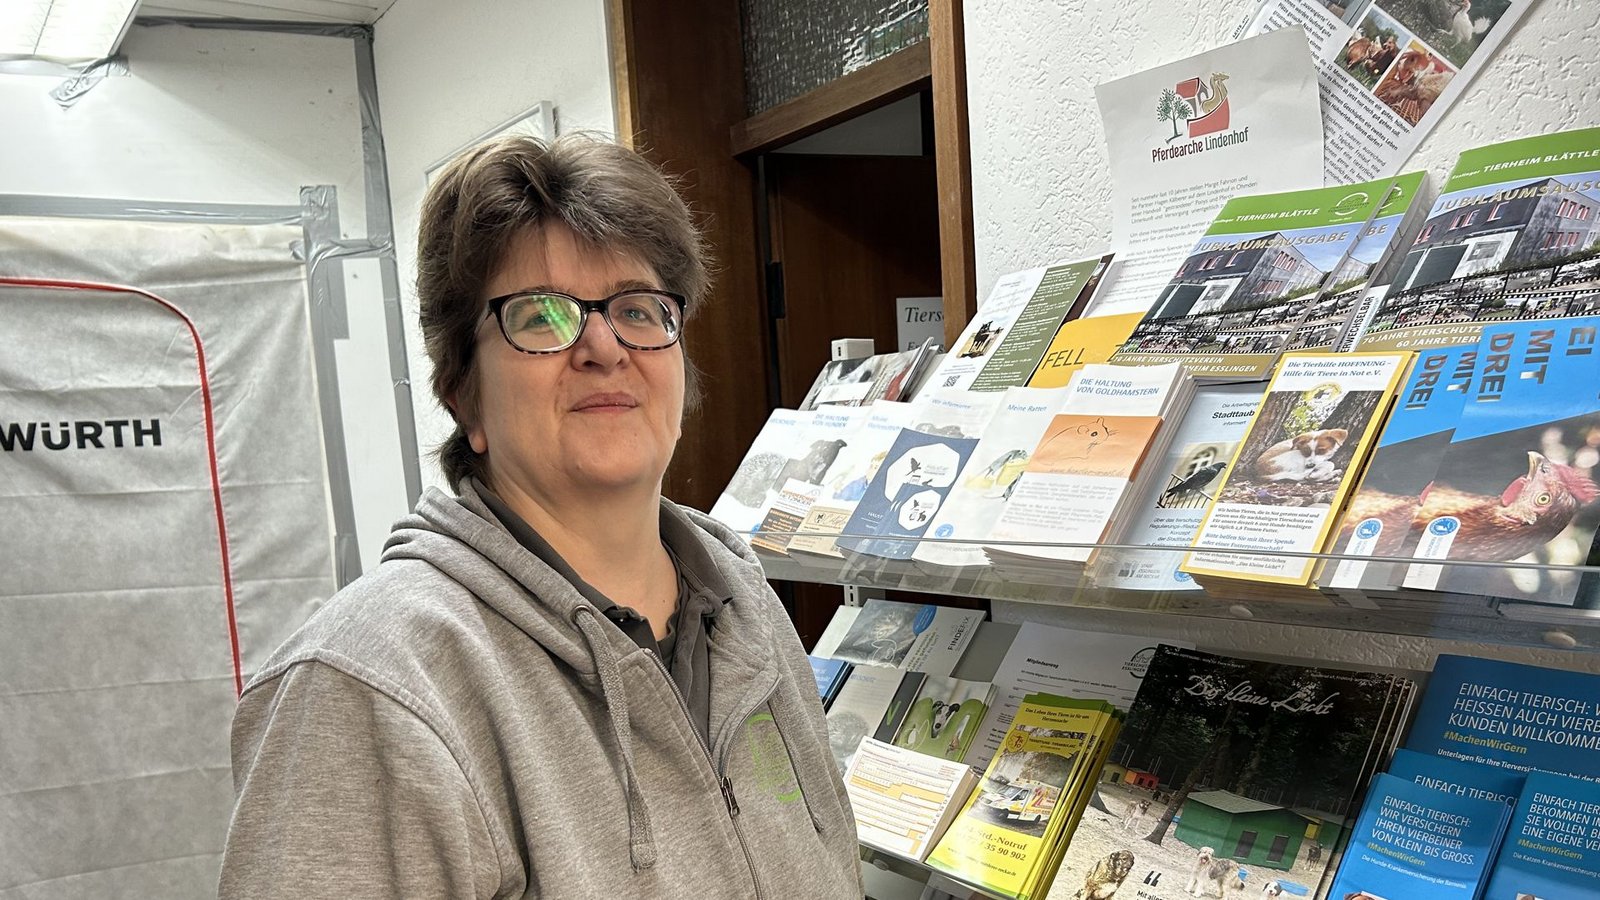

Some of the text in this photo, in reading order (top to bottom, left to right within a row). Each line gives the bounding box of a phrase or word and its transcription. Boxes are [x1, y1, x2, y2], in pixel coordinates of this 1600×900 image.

[1333, 68, 1347, 83] Monate
[1348, 80, 1359, 92] alten
[1359, 90, 1374, 105] Hennen
[1152, 126, 1249, 163] Pferdearche Lindenhof
[1385, 138, 1398, 151] Leben
[1483, 149, 1600, 173] TIERHEIM BLÄTTLE
[1235, 211, 1279, 222] TIERHEIM
[1278, 208, 1321, 219] BLÄTTLE
[1197, 231, 1349, 252] JUBILÄUMSAUSGABE
[1361, 335, 1375, 345] 70
[1375, 330, 1411, 344] JAHRE
[1396, 338, 1411, 348] 60
[1411, 336, 1449, 347] JAHRE
[1041, 347, 1085, 370] FELL
[1148, 356, 1225, 364] TIERSCHUTZVEREIN
[1476, 332, 1515, 403] DREI
[1519, 329, 1556, 385] MIT
[1207, 365, 1258, 373] ESSLINGEN
[1348, 369, 1365, 377] Not
[1446, 351, 1478, 394] MIT
[1079, 378, 1132, 388] DIE HALTUNG
[1095, 387, 1160, 396] GOLDHAMSTERN
[1404, 354, 1448, 411] DREI
[1007, 404, 1027, 412] Meine
[1212, 410, 1256, 420] Stadttaub
[1271, 692, 1340, 715] Licht
[1459, 682, 1519, 704] EINFACH
[1522, 692, 1591, 715] TIERISCH:
[1448, 712, 1509, 735] KUNDEN
[1453, 697, 1514, 720] HEISSEN
[1515, 708, 1558, 728] AUCH
[1443, 730, 1528, 755] #MachenWirGern
[1437, 748, 1475, 762] Unterlagen
[1475, 755, 1486, 765] für
[1486, 757, 1501, 767] Ihre
[1414, 774, 1466, 797] EINFACH
[1384, 795, 1472, 828] EINFACH TIERISCH:
[1533, 792, 1577, 810] EINFACH
[1379, 806, 1462, 837] WIR VERSICHERN
[1526, 814, 1542, 828] SIE
[1542, 817, 1588, 837] WOLLEN.
[1529, 804, 1590, 825] BEKOMMEN
[1375, 818, 1463, 850] IHREN VIERBEINER
[1521, 825, 1544, 839] EINE
[1546, 831, 1584, 848] EIGENE
[984, 842, 1027, 861] 35 90 902
[1361, 854, 1372, 863] Die
[1366, 841, 1426, 868] #MachenWirGern
[1371, 828, 1475, 866] VON KLEIN BIS GROSS.
[1513, 851, 1524, 860] Die
[1517, 838, 1584, 861] #MachenWirGern
